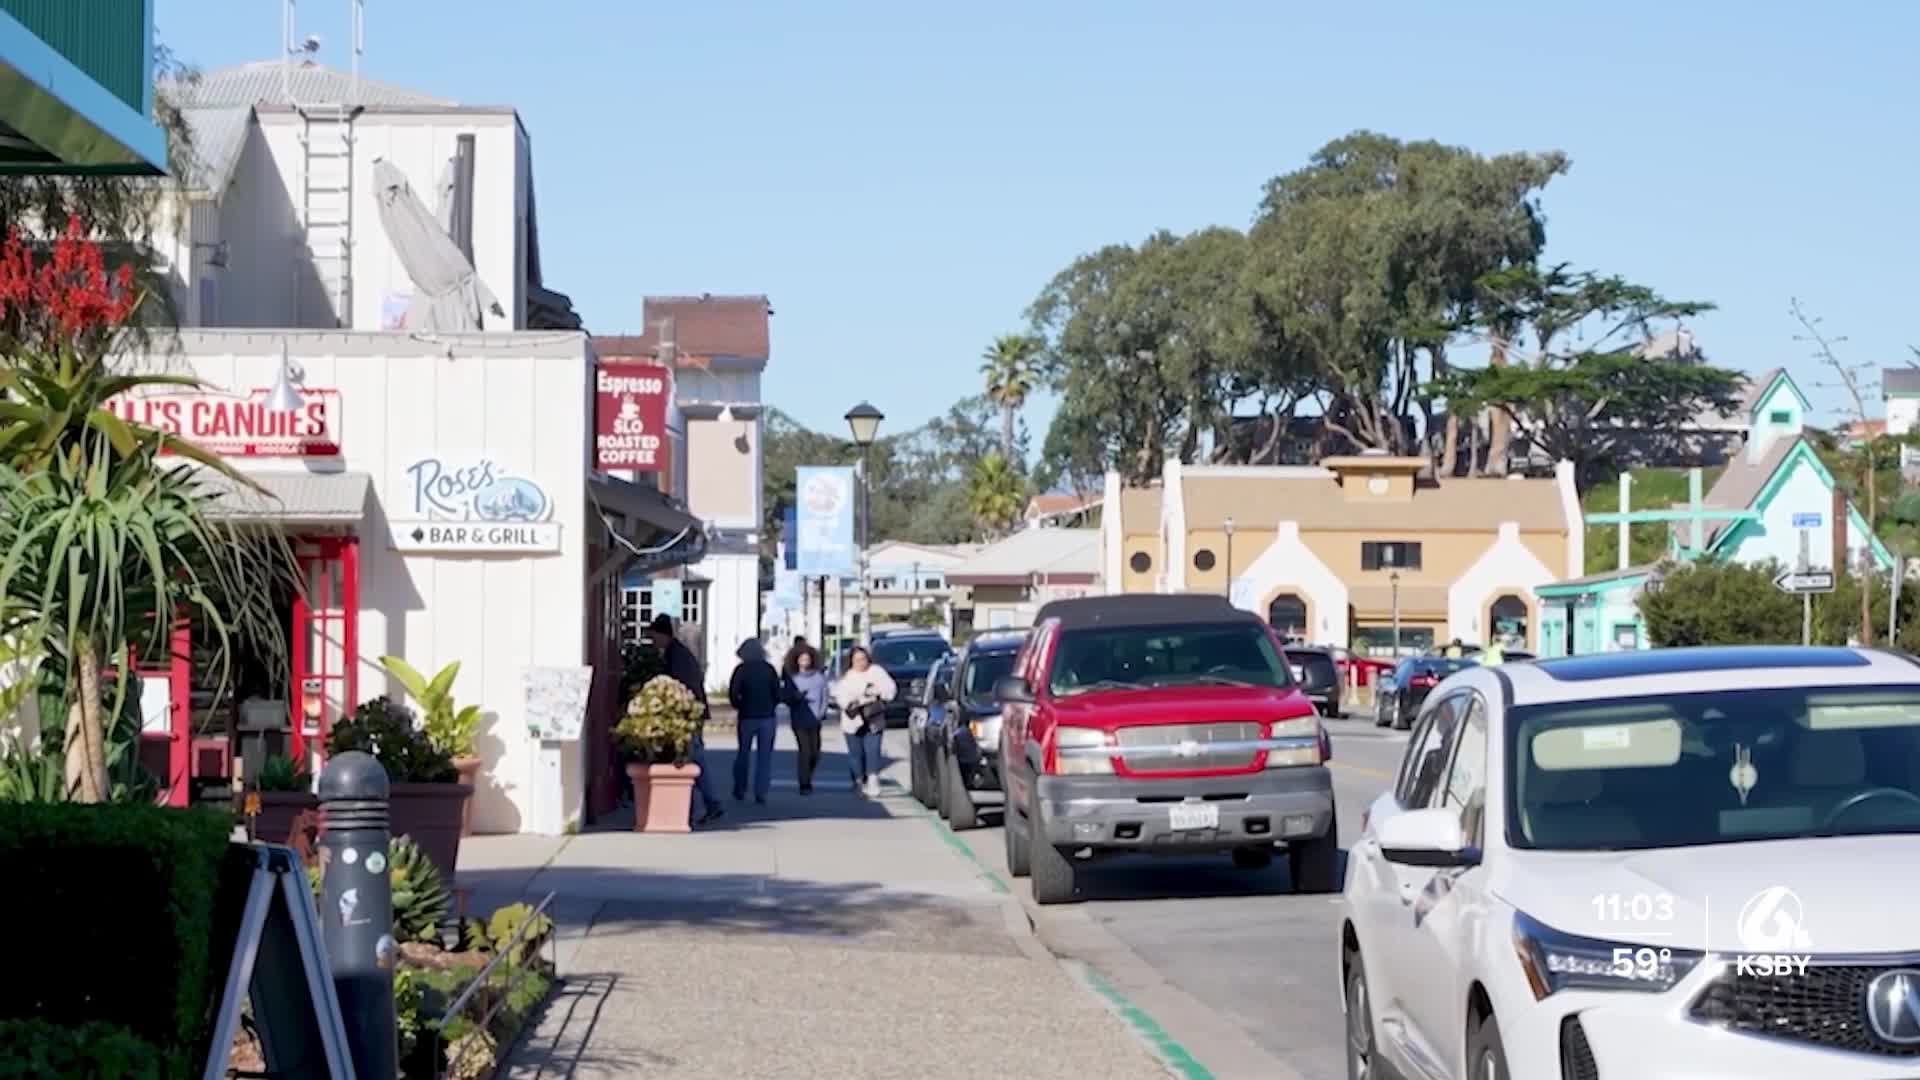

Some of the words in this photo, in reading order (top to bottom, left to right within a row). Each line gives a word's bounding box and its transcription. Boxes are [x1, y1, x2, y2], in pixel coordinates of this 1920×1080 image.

[598, 370, 662, 399] Espresso
[191, 401, 325, 437] CANDIES
[613, 418, 644, 434] SLO
[597, 434, 660, 449] ROASTED
[599, 449, 655, 465] COFFEE
[430, 528, 467, 544] BAR
[471, 528, 485, 544] &
[488, 528, 539, 545] GRILL
